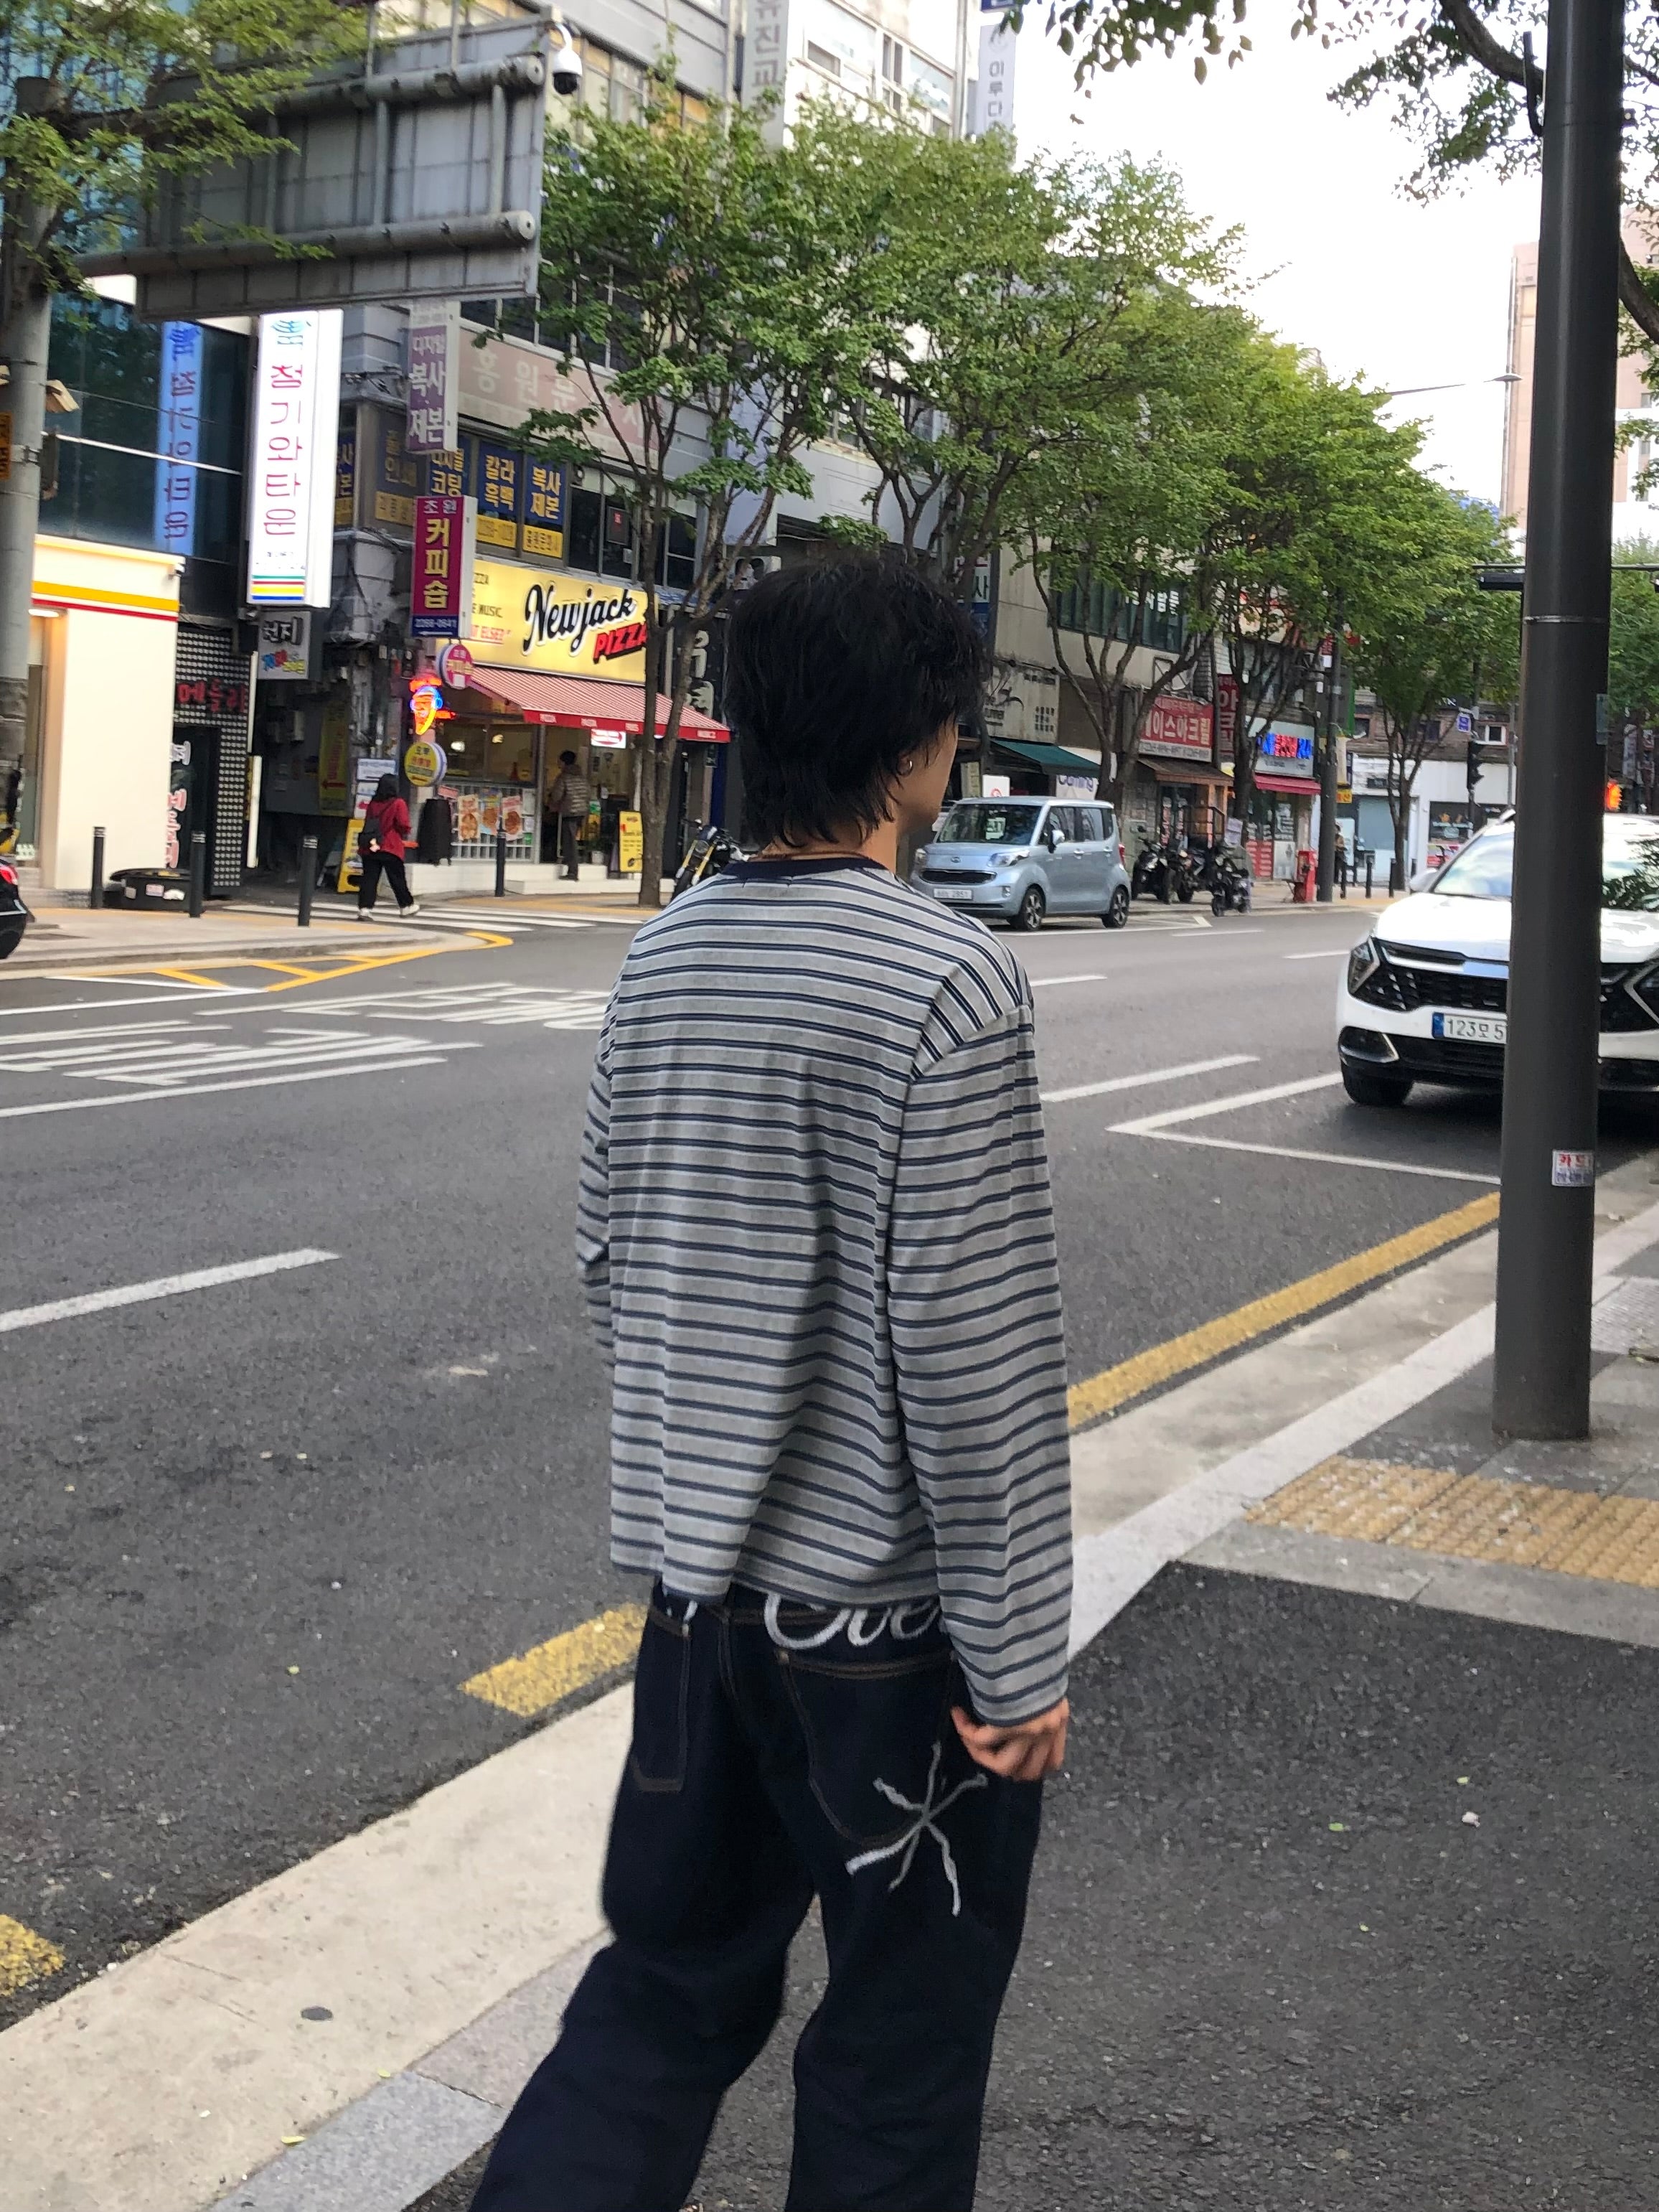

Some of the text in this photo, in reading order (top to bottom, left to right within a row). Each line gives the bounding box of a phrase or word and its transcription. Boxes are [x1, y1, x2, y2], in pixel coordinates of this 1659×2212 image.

[411, 360, 446, 397] 복사
[409, 408, 443, 444] 제본
[431, 470, 463, 497] 코팅
[485, 454, 515, 484] 칼라
[532, 467, 562, 496] 복사
[530, 492, 560, 520] 제본
[423, 517, 451, 609] 커피숍
[524, 584, 634, 653] Newjack
